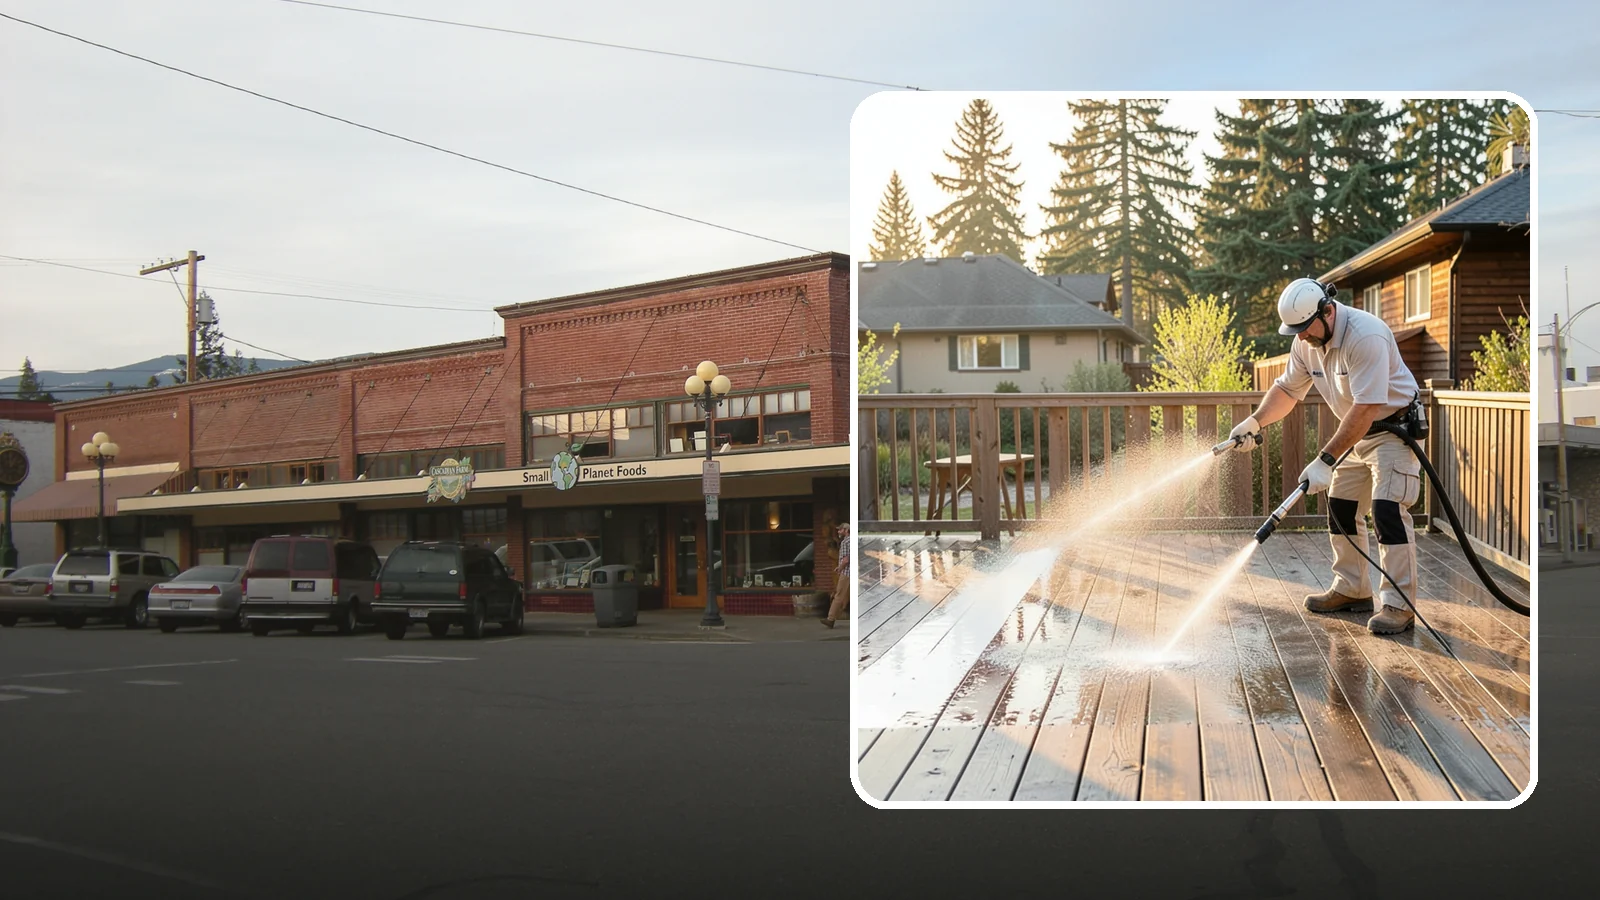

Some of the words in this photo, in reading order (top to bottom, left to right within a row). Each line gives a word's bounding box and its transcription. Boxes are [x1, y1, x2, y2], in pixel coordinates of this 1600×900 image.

[523, 471, 549, 483] Small
[583, 467, 614, 479] Planet
[617, 464, 647, 477] Foods
